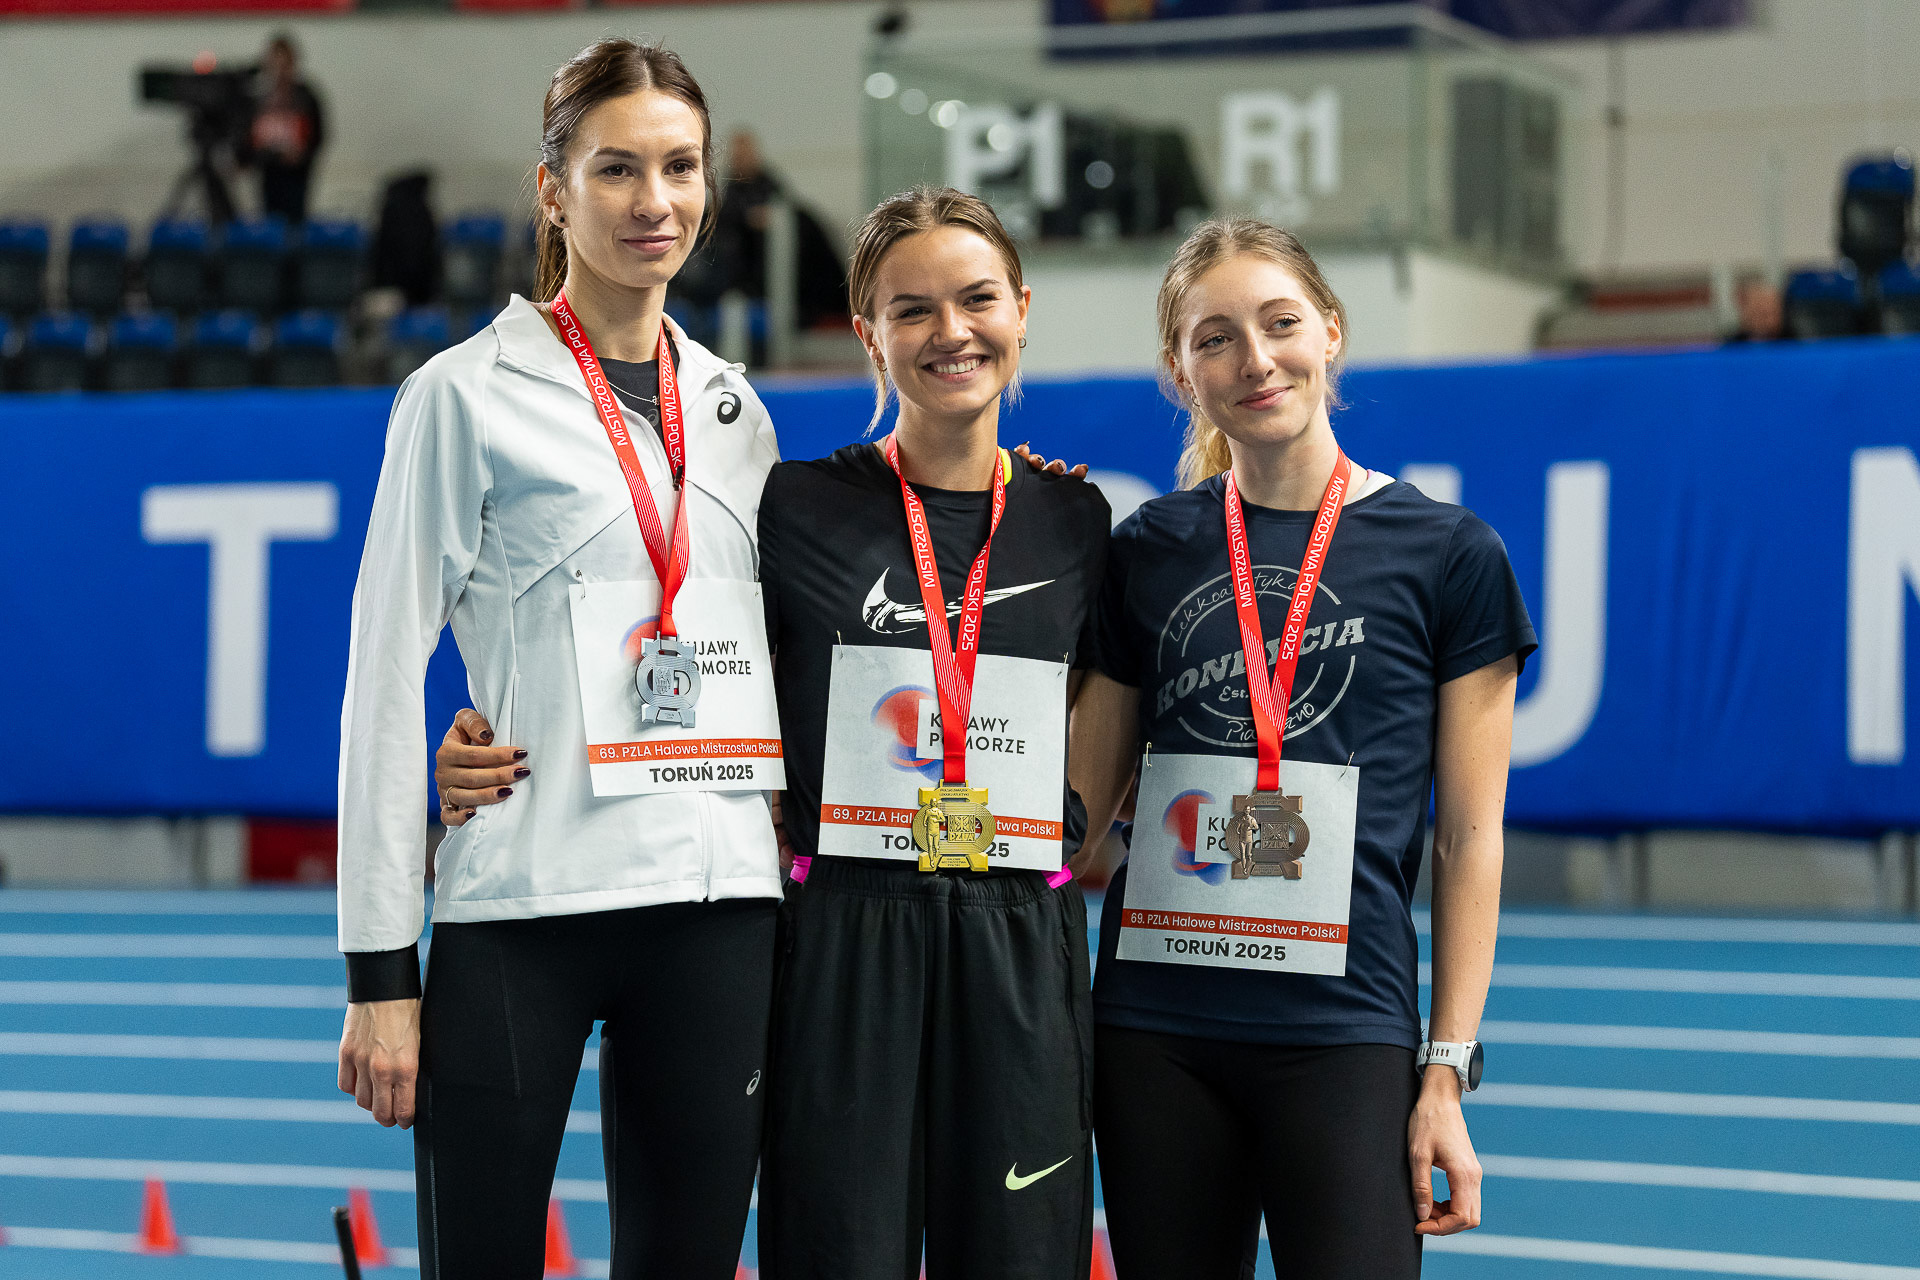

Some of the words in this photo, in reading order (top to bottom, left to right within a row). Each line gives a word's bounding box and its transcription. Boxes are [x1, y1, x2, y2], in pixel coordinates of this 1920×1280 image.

[1220, 88, 1340, 196] R1
[556, 304, 585, 349] POLSKI
[579, 348, 628, 446] MISTRZOSTWA
[666, 424, 683, 470] POLSK
[1304, 475, 1345, 571] MISTRZOSTWA
[1230, 514, 1253, 608] MISTRZOSTWA
[964, 560, 985, 612] POLSKI
[1290, 573, 1316, 623] POLSKI
[961, 615, 978, 651] 2025
[1281, 624, 1300, 661] 2025
[692, 660, 752, 675] MORZE
[930, 713, 1010, 733] KAWY
[1225, 702, 1315, 742] Piazno
[599, 746, 619, 759] 69.
[622, 745, 652, 758] PZLA
[654, 744, 698, 757] Halowe
[701, 742, 757, 755] Mistrzostwa
[758, 742, 779, 754] Polski
[929, 732, 1026, 754] PMORZE
[649, 761, 714, 783] TORUŃ
[717, 764, 754, 781] 2025
[832, 808, 853, 821] 69.
[856, 809, 887, 823] PZLA
[1022, 822, 1056, 837] Polski
[988, 841, 1010, 858] 25
[1130, 912, 1145, 925] 69.
[1147, 914, 1170, 926] PZLA
[1172, 916, 1216, 929] Halowe
[1219, 919, 1298, 936] Mistrzostwa
[1301, 925, 1341, 940] Polski
[1164, 937, 1230, 957] TORUŃ
[1235, 943, 1287, 961] 2025
